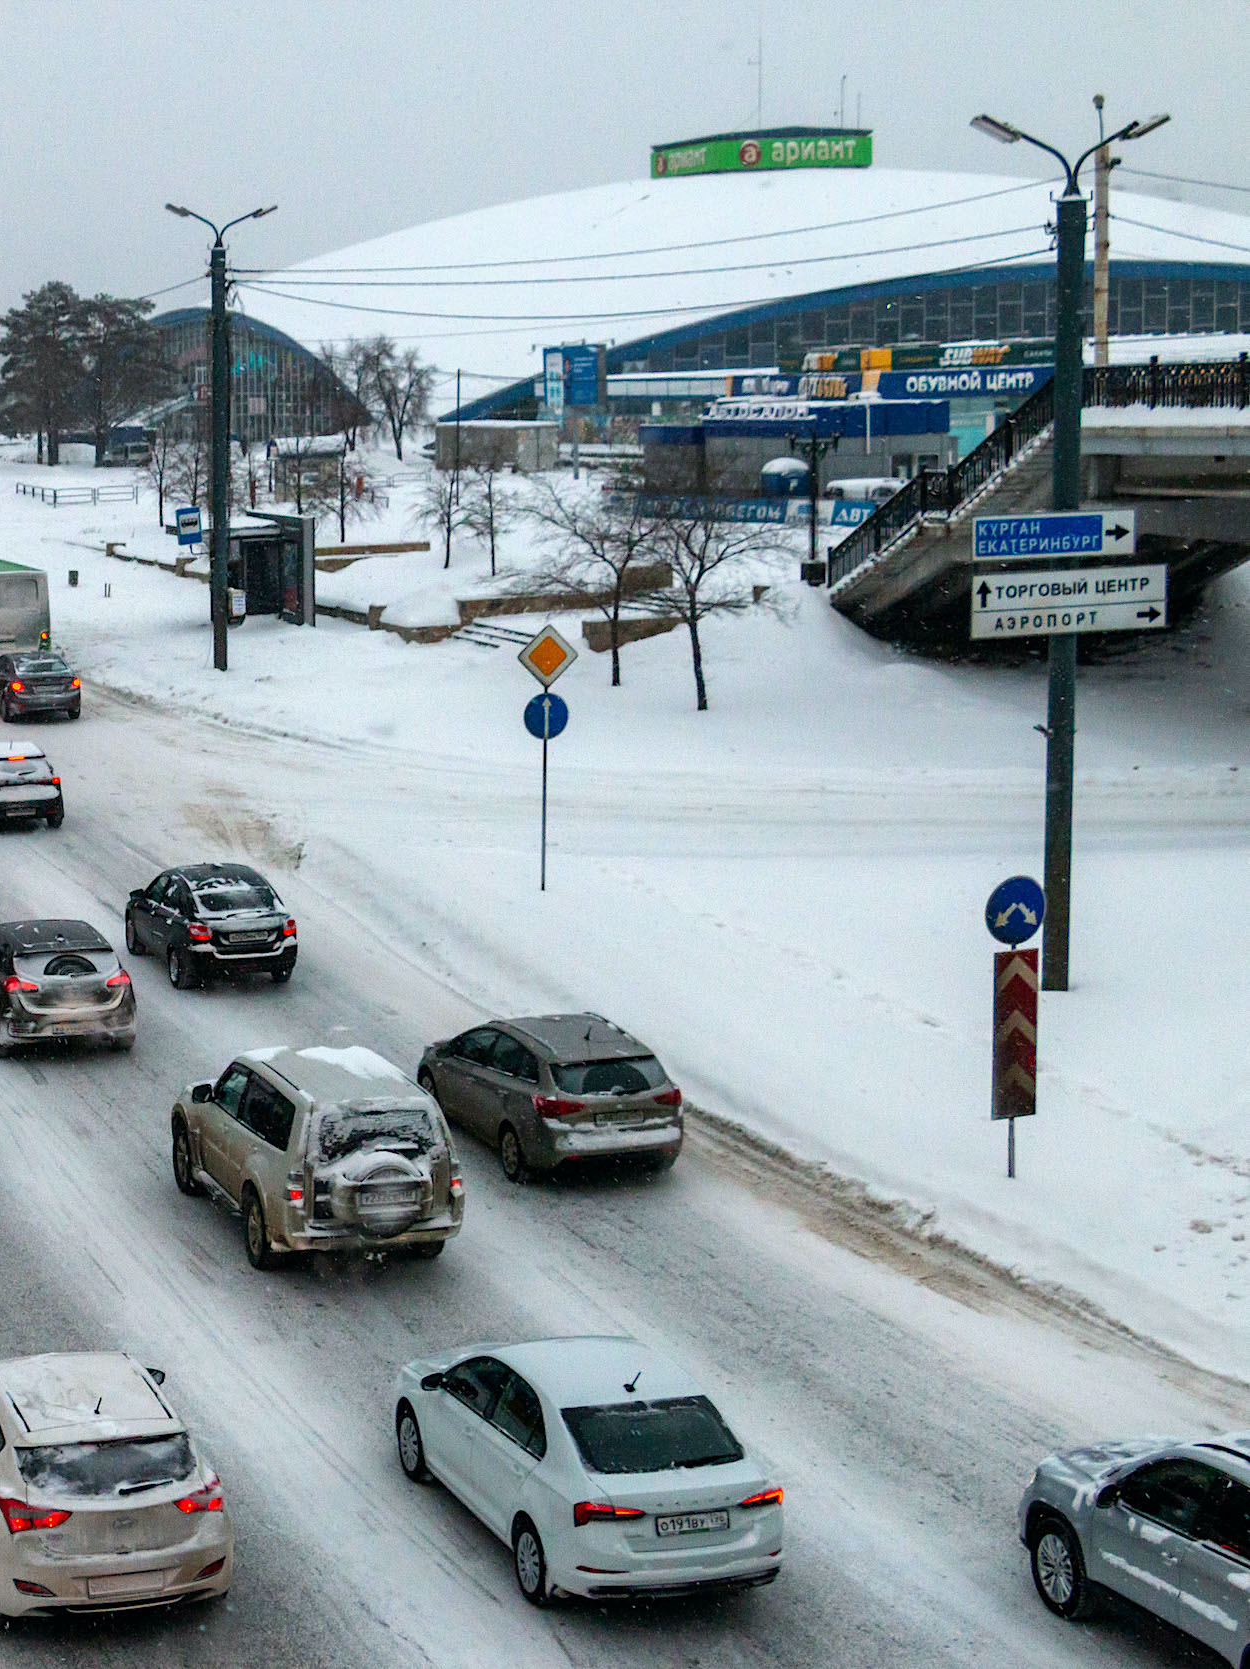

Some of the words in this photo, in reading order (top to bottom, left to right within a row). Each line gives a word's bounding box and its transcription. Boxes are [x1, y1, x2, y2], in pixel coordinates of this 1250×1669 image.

[771, 140, 856, 166] ариант
[906, 370, 981, 392] ОБУВНОЙ
[986, 371, 1034, 390] ЦЕНТР
[978, 521, 1041, 536] КУРГАН
[978, 535, 1100, 554] ЕКАТЕРИНБУРГ
[996, 579, 1087, 600] ТОРГОВЫЙ
[1095, 577, 1150, 595] ЦЕНТР
[995, 611, 1097, 631] АЭРОПОРТ
